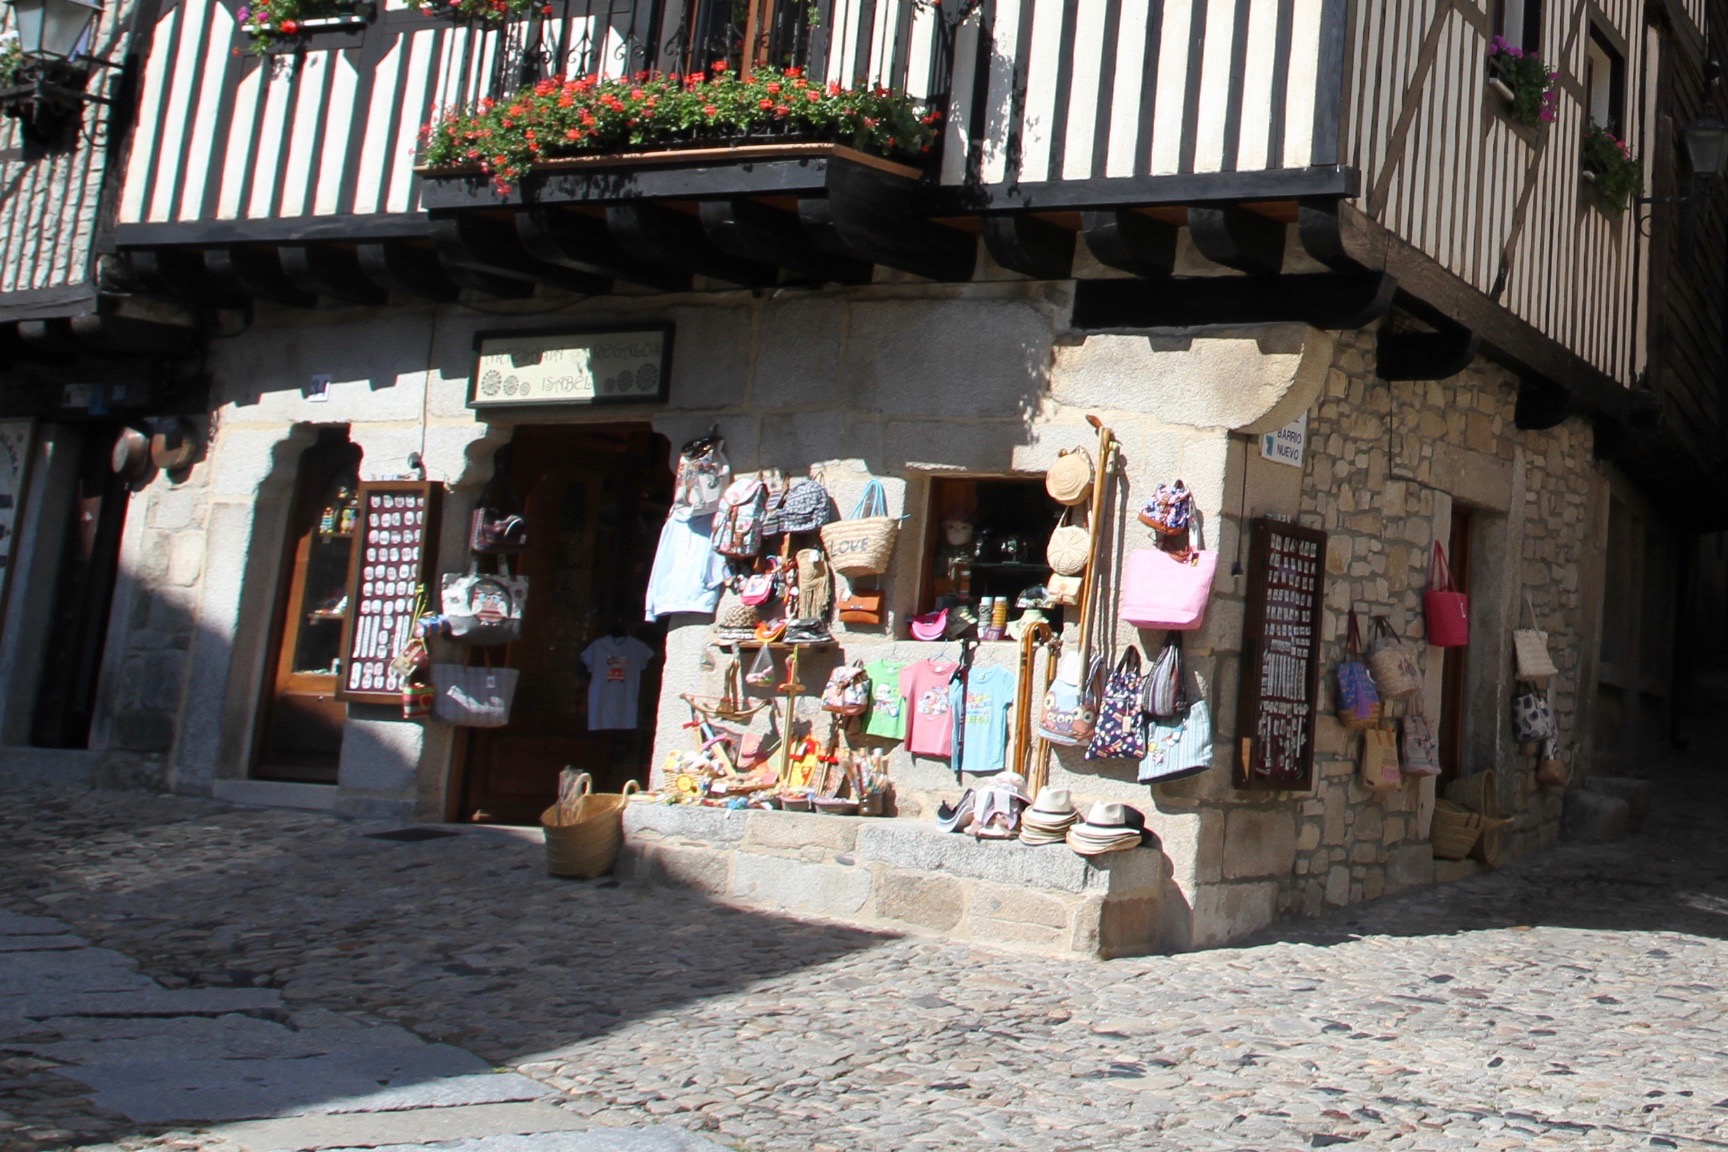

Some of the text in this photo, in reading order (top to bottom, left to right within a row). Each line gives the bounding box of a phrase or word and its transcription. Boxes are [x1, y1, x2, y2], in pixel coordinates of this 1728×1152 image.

[541, 375, 592, 392] ISABEL
[1277, 429, 1302, 444] BARRIO
[1277, 444, 1299, 460] NUEVO
[829, 537, 869, 557] LOVE
